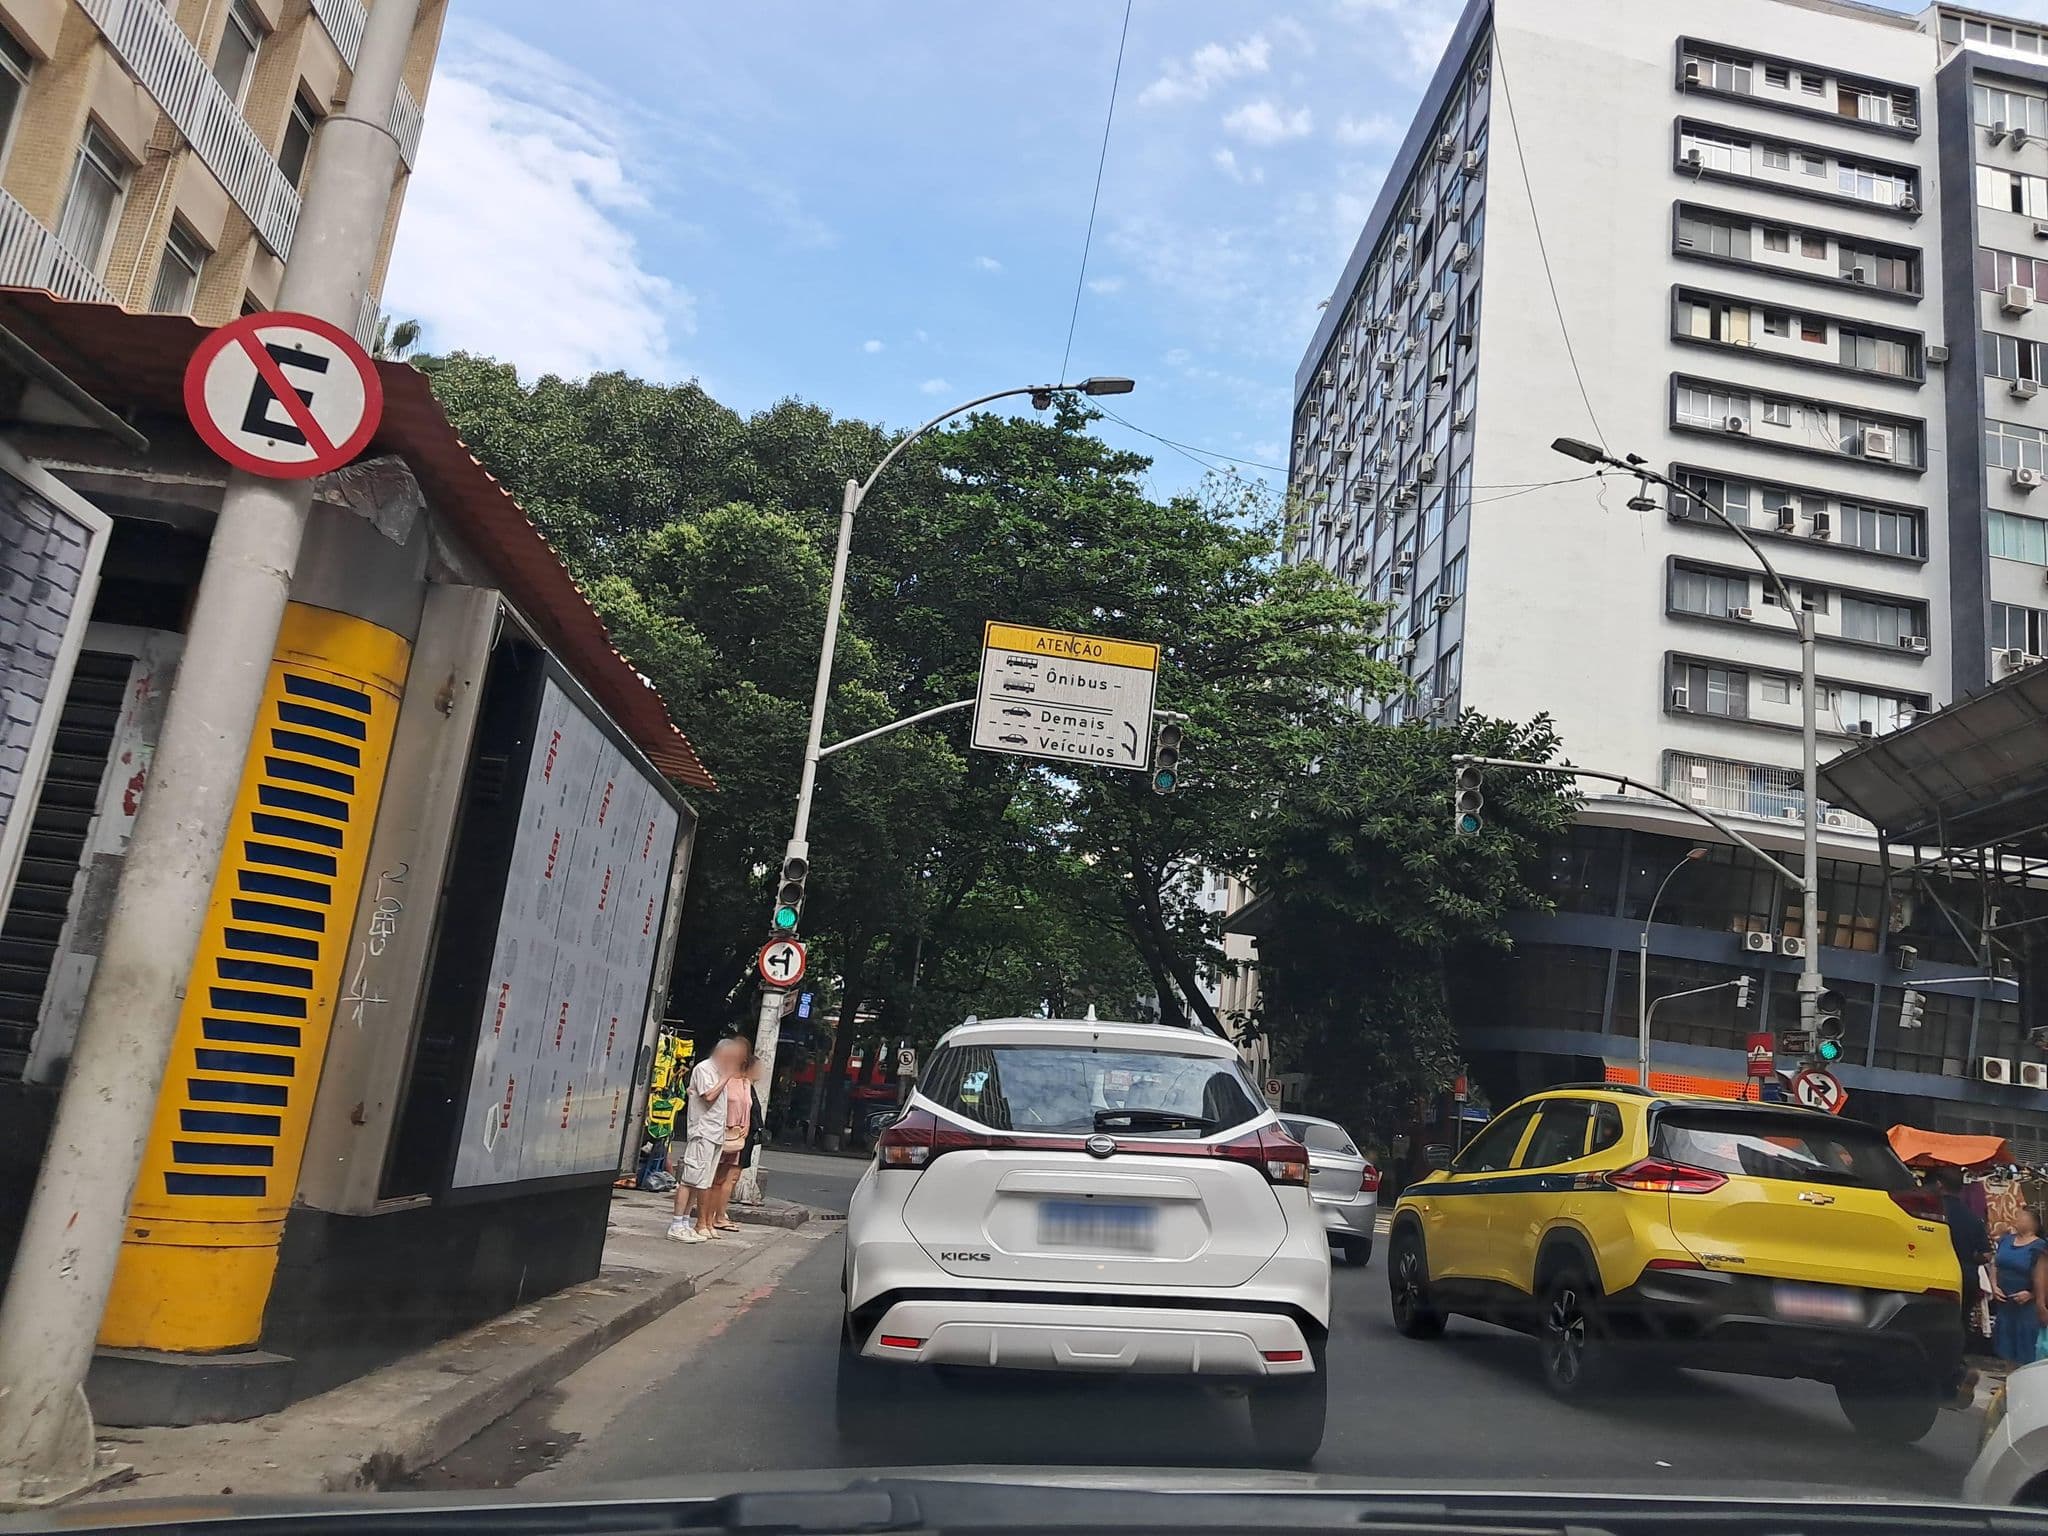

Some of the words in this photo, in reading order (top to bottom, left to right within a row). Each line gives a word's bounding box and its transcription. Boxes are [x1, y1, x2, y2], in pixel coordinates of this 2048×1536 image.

[241, 343, 330, 446] E
[1036, 637, 1103, 657] ATENÇÃO
[1046, 668, 1108, 690] Ônibus
[1041, 711, 1105, 730] Demais
[544, 730, 561, 784] klar
[1039, 736, 1115, 758] Veículos
[599, 781, 613, 828] klar
[545, 826, 561, 879] klar
[598, 864, 611, 910] klar
[494, 983, 510, 1039] klar
[555, 1002, 569, 1052] klar
[501, 1073, 514, 1129] klar
[941, 1252, 991, 1261] KICKS
